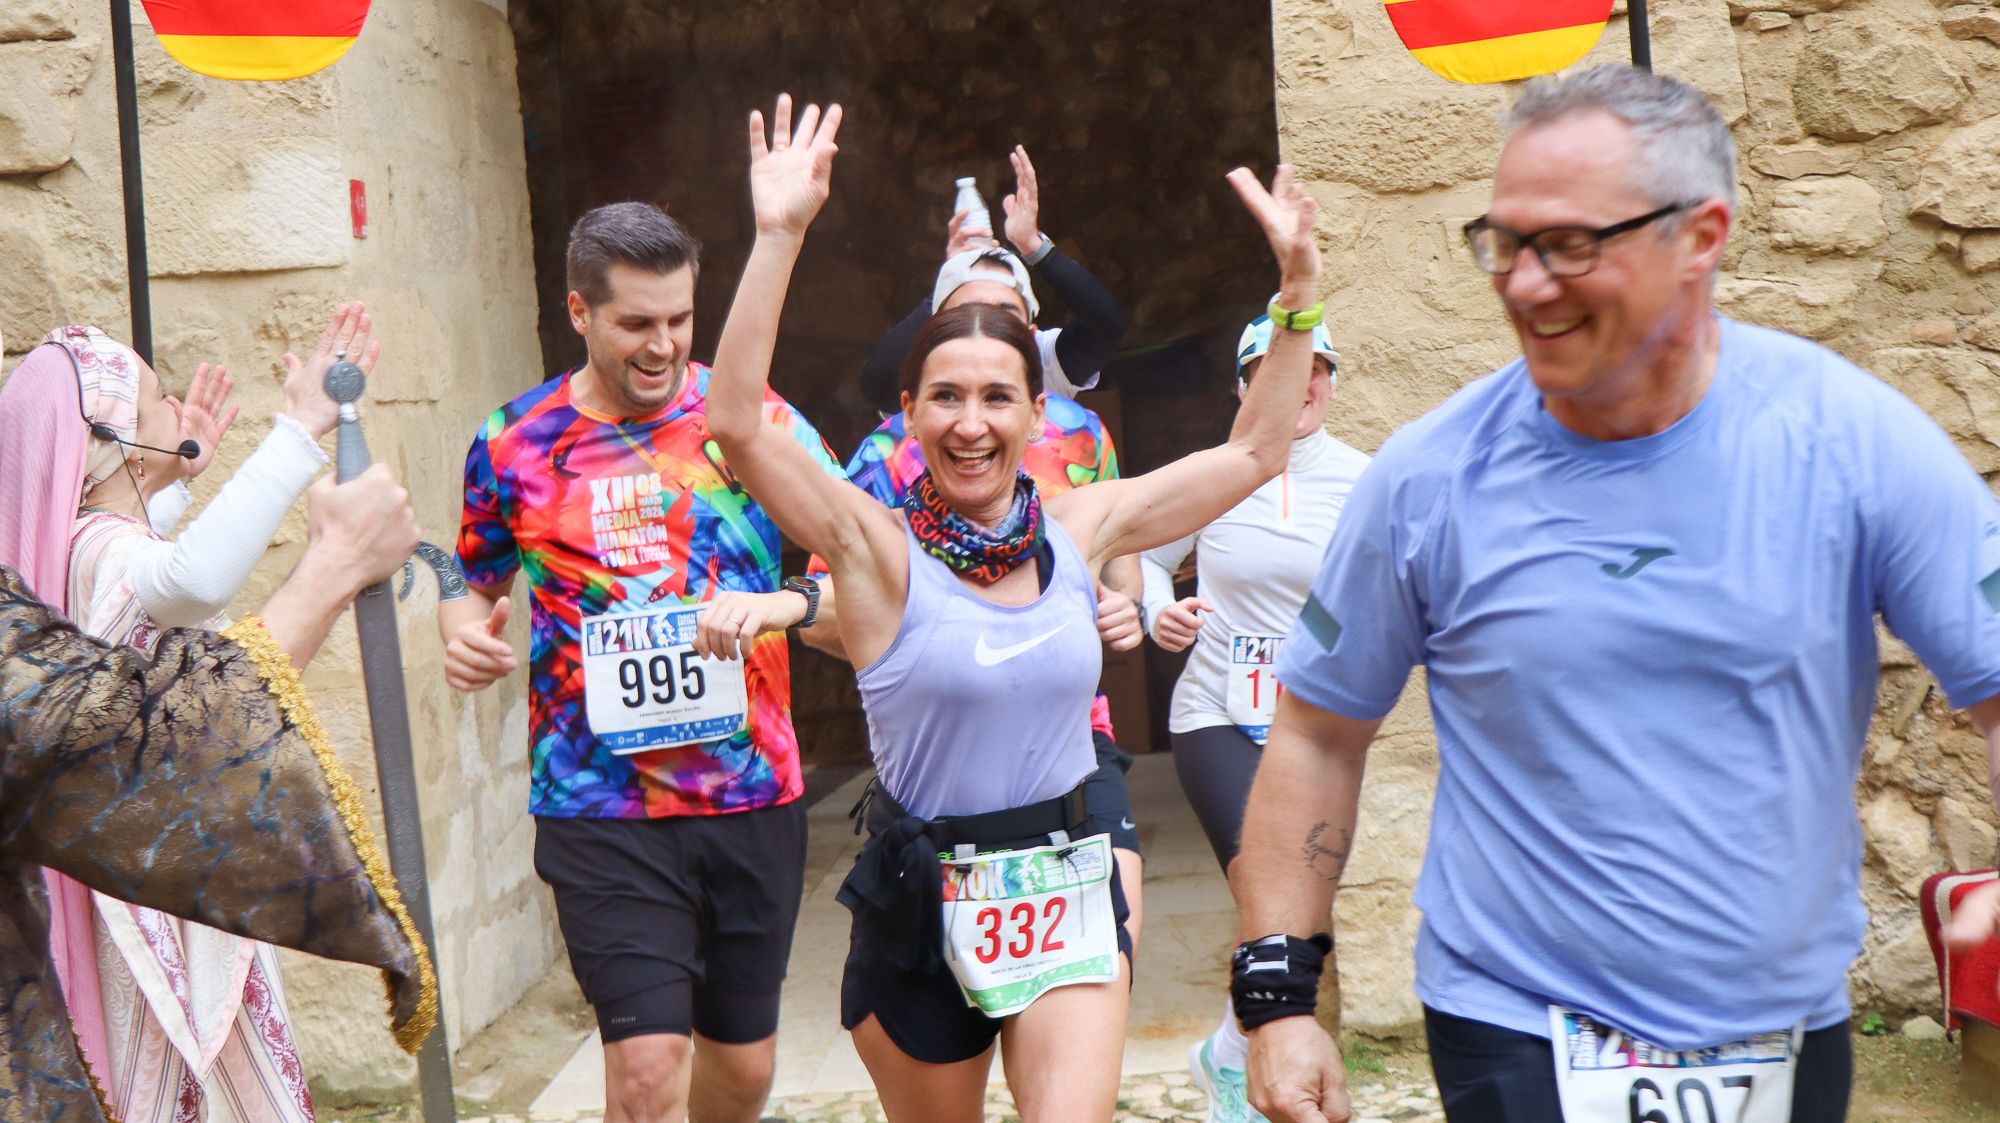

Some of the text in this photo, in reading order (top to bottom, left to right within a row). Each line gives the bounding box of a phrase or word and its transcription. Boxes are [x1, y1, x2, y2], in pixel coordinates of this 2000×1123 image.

[589, 473, 662, 513] XII 08
[639, 496, 663, 506] MARZO
[592, 509, 641, 532] MEDIA
[640, 507, 664, 519] 2026
[595, 523, 668, 551] MARATÓN
[608, 548, 639, 568] 10K
[640, 552, 671, 564] LUCENA
[603, 617, 652, 653] 21K
[619, 651, 706, 708] 995
[976, 897, 1067, 964] 332
